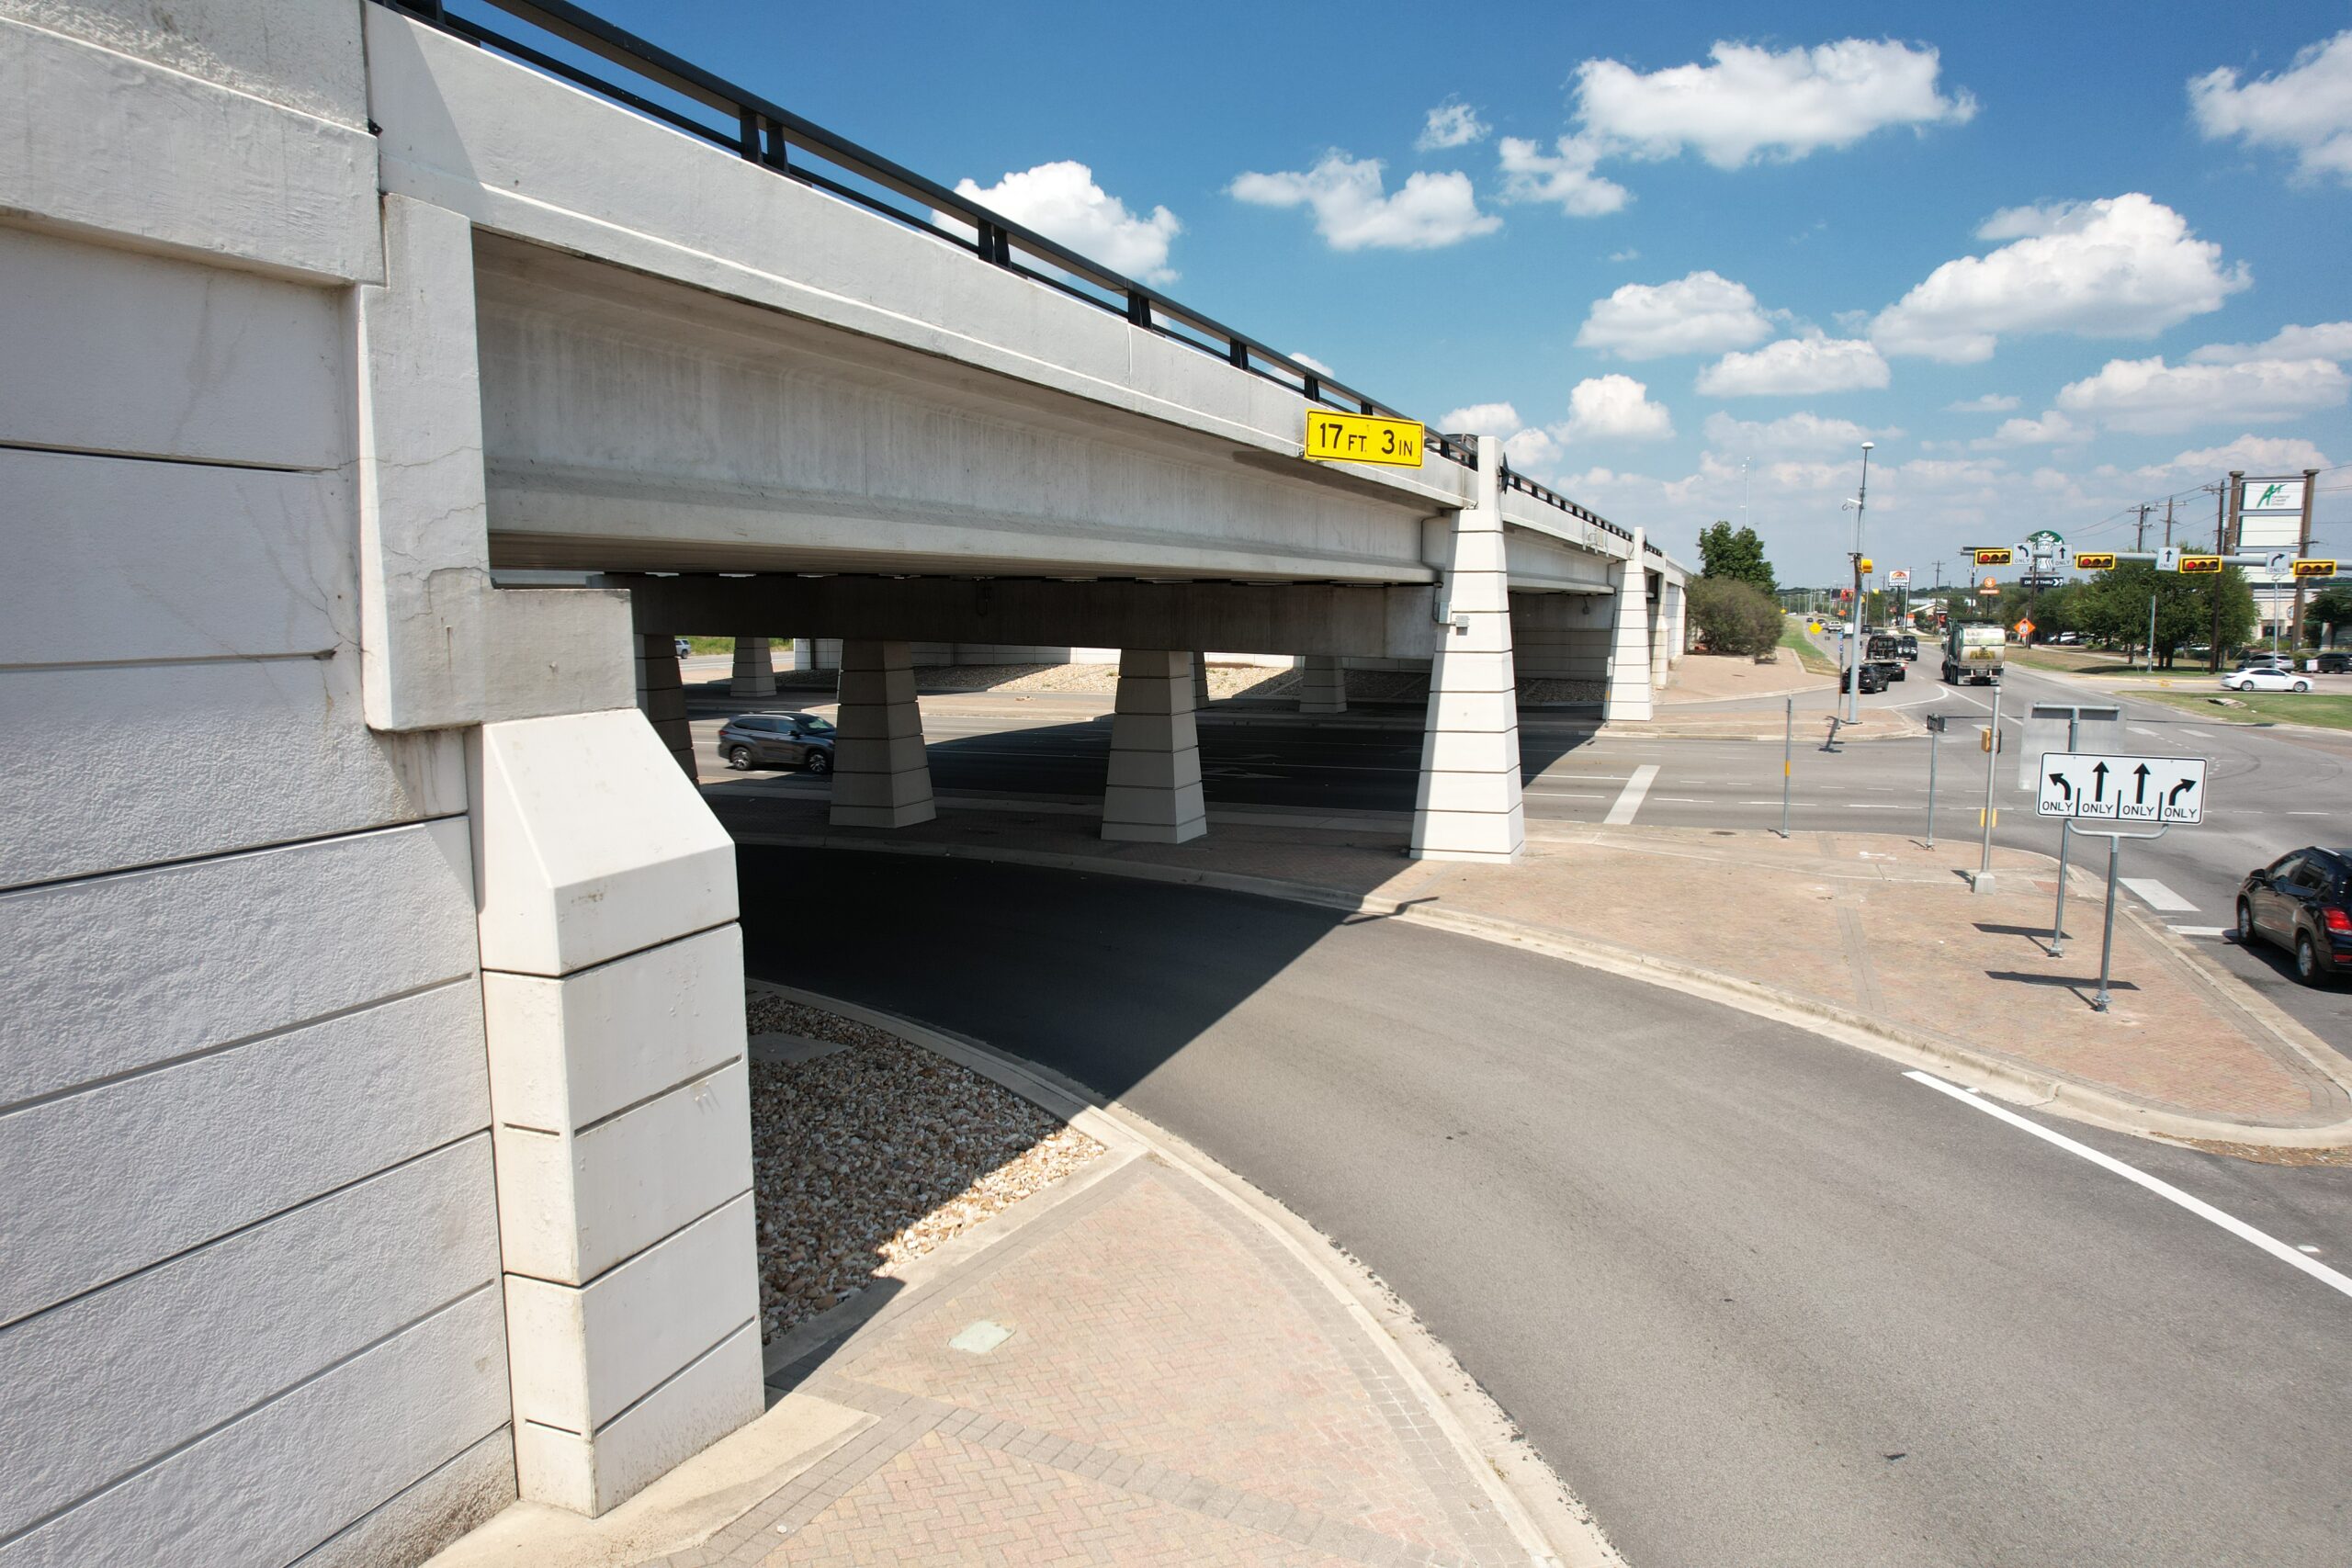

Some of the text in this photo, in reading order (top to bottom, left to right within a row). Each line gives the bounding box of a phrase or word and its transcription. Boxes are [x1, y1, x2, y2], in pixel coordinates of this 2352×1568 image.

[1319, 423, 1413, 457] 17 FT 3 IN
[2041, 801, 2073, 812] ONLY
[2082, 803, 2113, 814] ONLY
[2122, 805, 2154, 817] ONLY
[2165, 807, 2197, 818] ONLY
